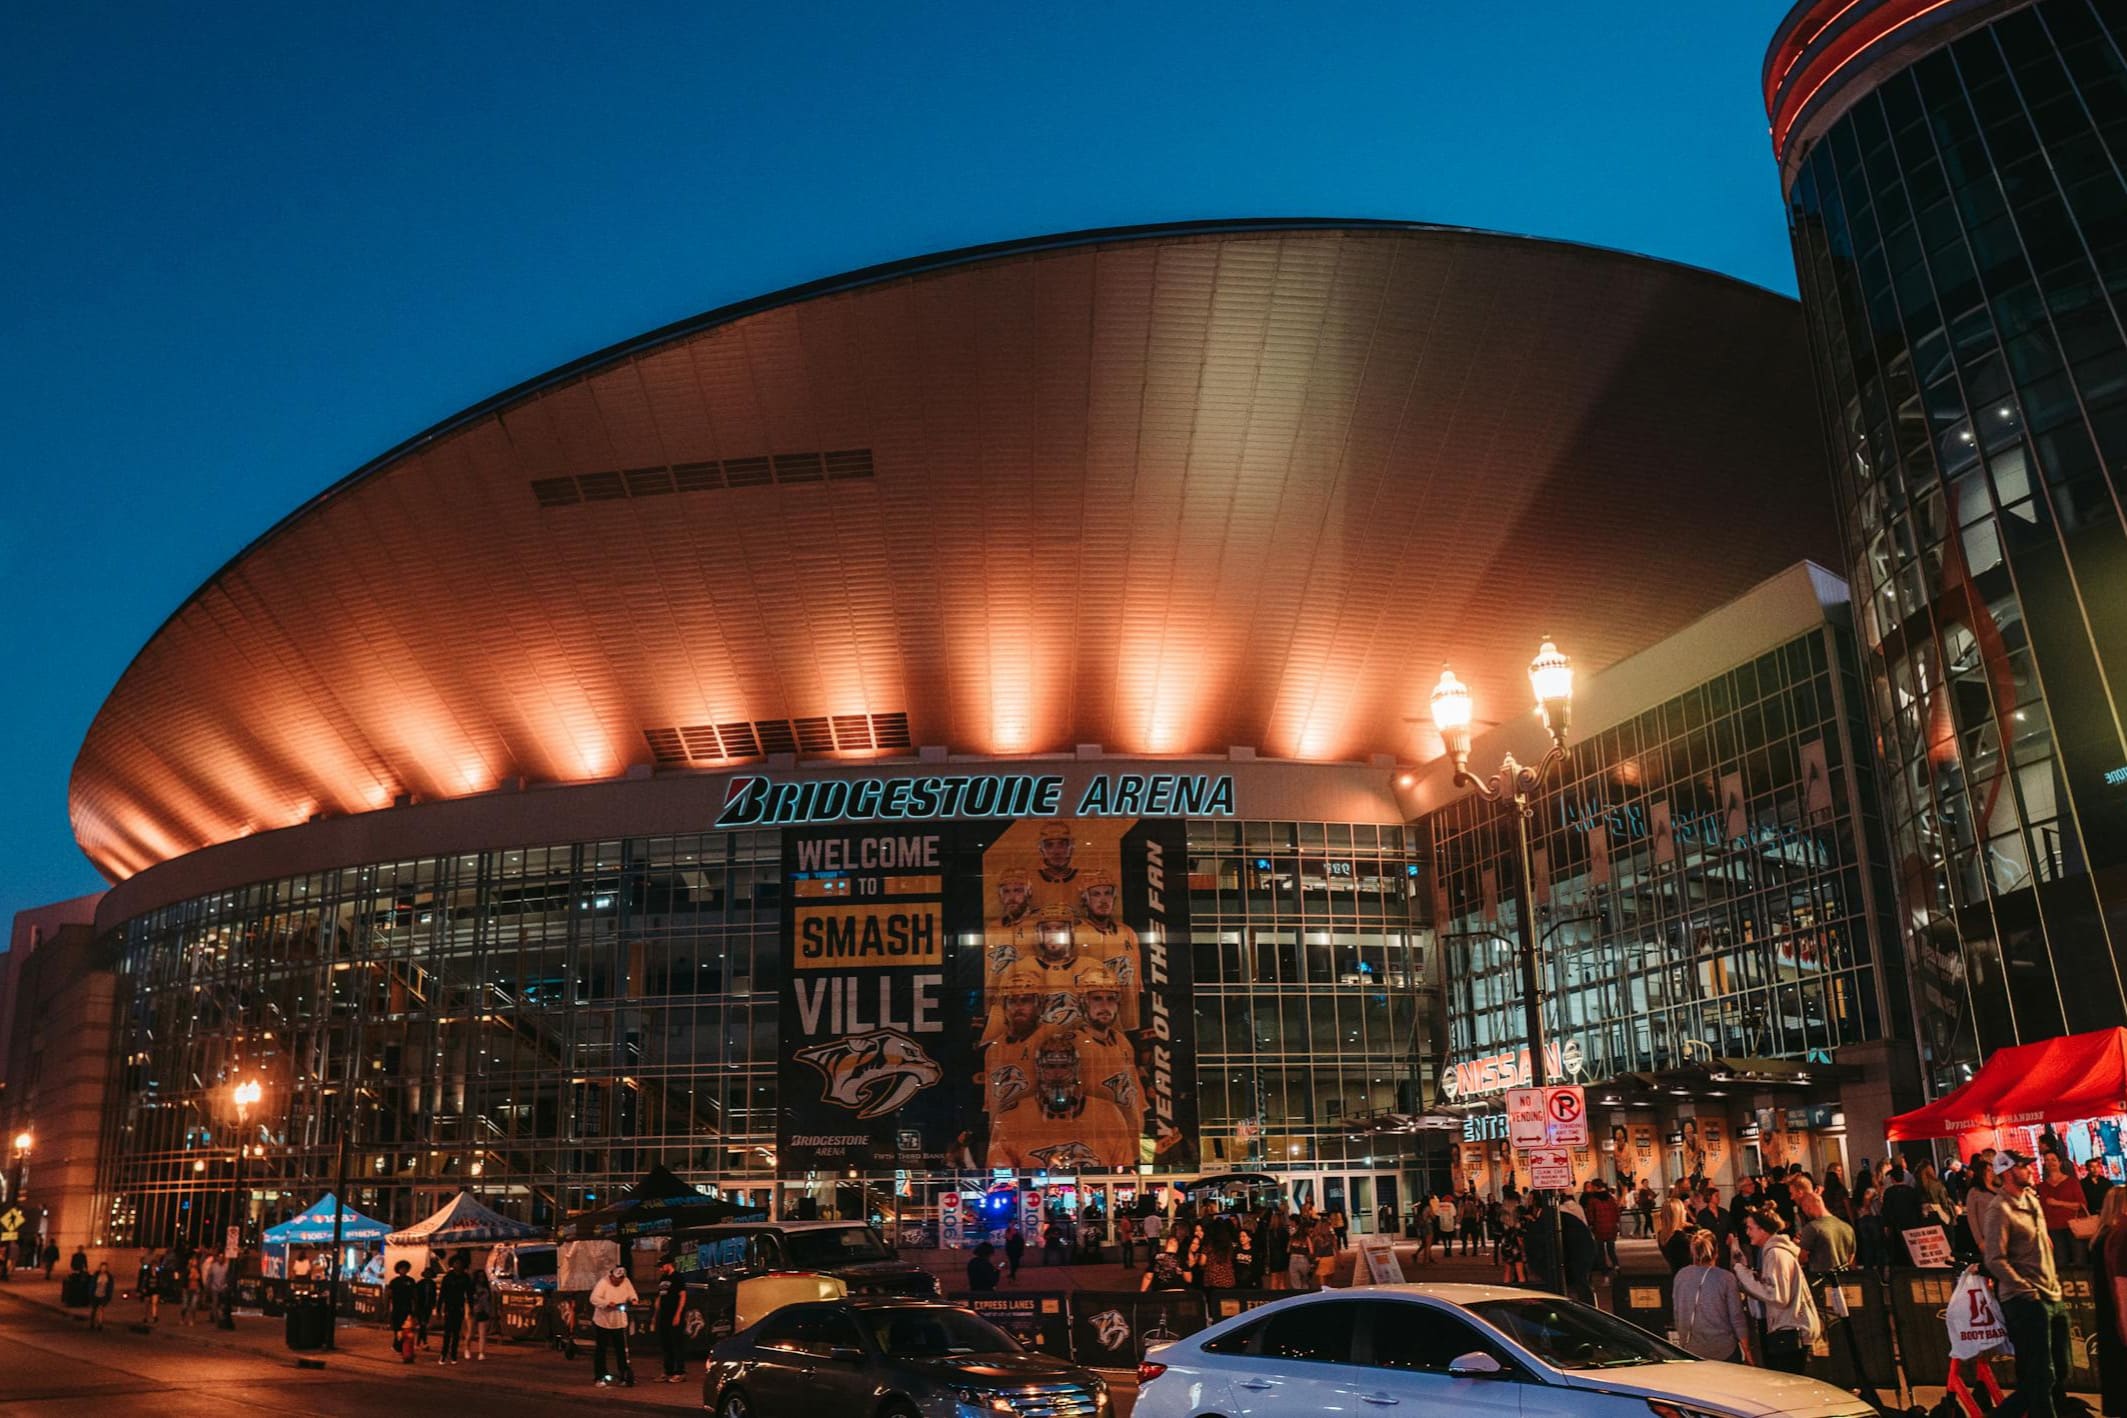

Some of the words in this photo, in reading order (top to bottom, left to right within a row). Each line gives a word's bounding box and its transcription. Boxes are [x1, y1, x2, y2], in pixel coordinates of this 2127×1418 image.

[714, 775, 1064, 828] BRIDGESTONE
[1076, 774, 1236, 817] ARENA
[797, 836, 941, 872] WELCOME
[858, 877, 877, 895] TO
[1146, 840, 1166, 914] FAN
[803, 914, 933, 958] SMASH
[1149, 917, 1169, 985] THE
[793, 974, 944, 1036] VILLE
[1152, 991, 1171, 1042] OF
[1457, 1042, 1563, 1096] NISSAN
[1154, 1044, 1174, 1137] YEAR
[1519, 1095, 1531, 1107] NO
[1511, 1111, 1544, 1123] VENDING
[790, 1134, 870, 1147] BRIDGESTONE
[815, 1147, 846, 1157] ARENA
[974, 1300, 1008, 1310] EXPRESS
[1009, 1299, 1035, 1309] LANES
[1960, 1330, 1984, 1341] BOOT
